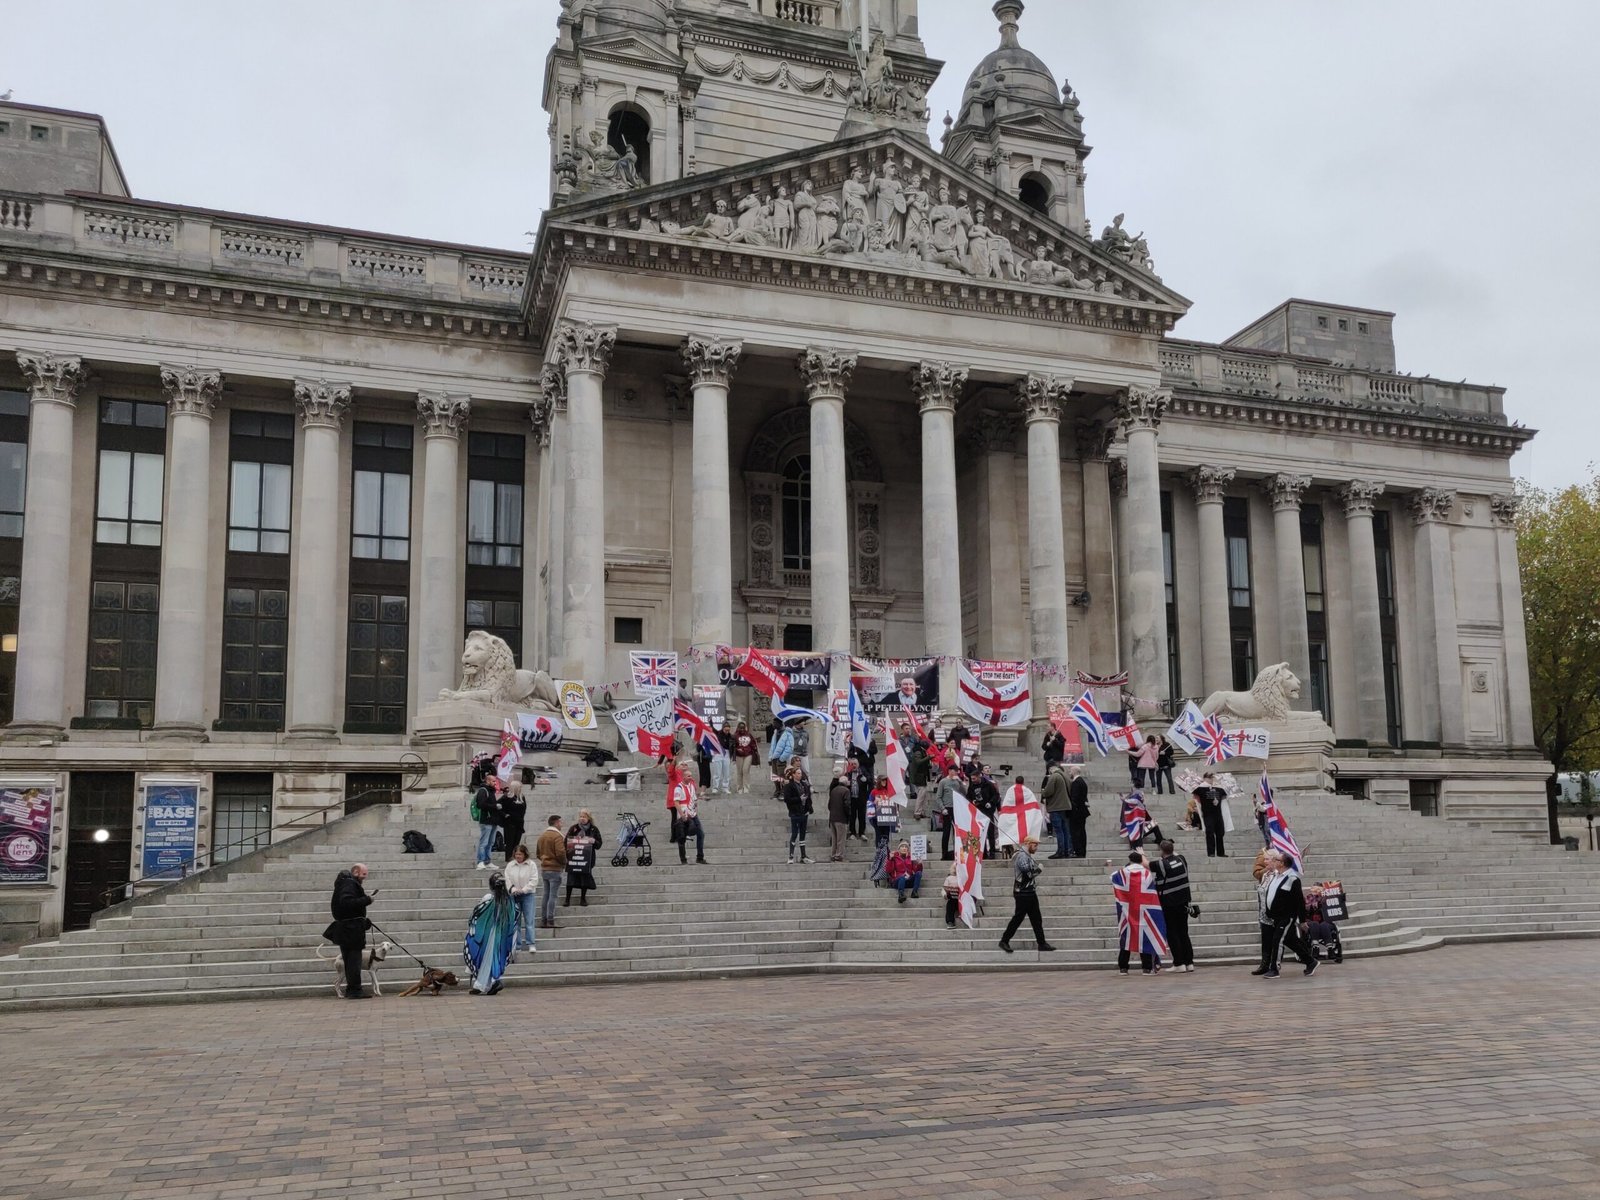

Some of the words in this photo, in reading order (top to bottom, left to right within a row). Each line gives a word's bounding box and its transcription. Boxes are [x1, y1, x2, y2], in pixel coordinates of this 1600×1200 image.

[874, 666, 917, 674] PATRIOT
[614, 692, 669, 721] COMMUNISM
[703, 707, 718, 715] THEY
[875, 703, 906, 712] PETER
[908, 704, 938, 712] LYNCH
[640, 710, 656, 725] OR
[1226, 734, 1267, 744] ESUS
[153, 807, 195, 819] BASE
[14, 846, 32, 855] lens
[16, 842, 30, 850] the
[1322, 887, 1340, 897] #SAVE
[1326, 898, 1339, 906] OUR
[1327, 908, 1343, 917] KIDS
